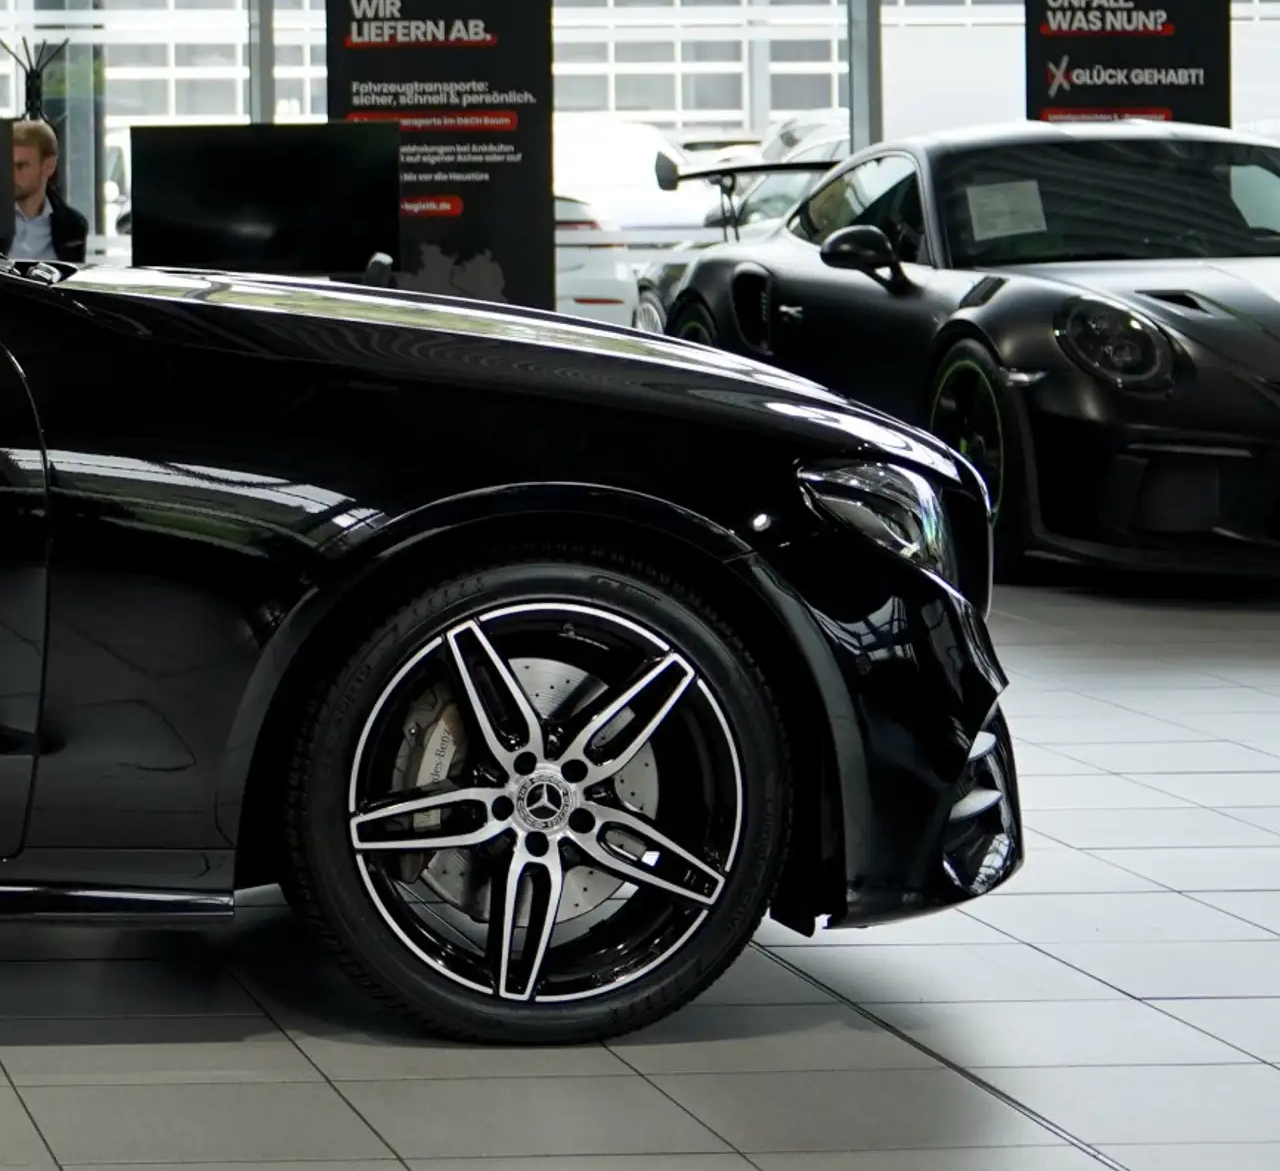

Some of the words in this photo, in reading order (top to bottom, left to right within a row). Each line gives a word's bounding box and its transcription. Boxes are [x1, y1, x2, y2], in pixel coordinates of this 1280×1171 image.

[350, 20, 446, 43] LIEFERN
[448, 19, 492, 42] AB.
[1046, 9, 1104, 32] WAS
[1105, 9, 1168, 32] NUN?
[1072, 64, 1129, 86] GLÜCK
[1130, 67, 1205, 86] GEHABT!
[351, 81, 489, 95] Fahrzeugtransporte:
[351, 92, 397, 107] sicher,
[399, 91, 447, 106] schnell
[462, 91, 537, 107] persönlich.
[431, 729, 452, 782] des-Benz
